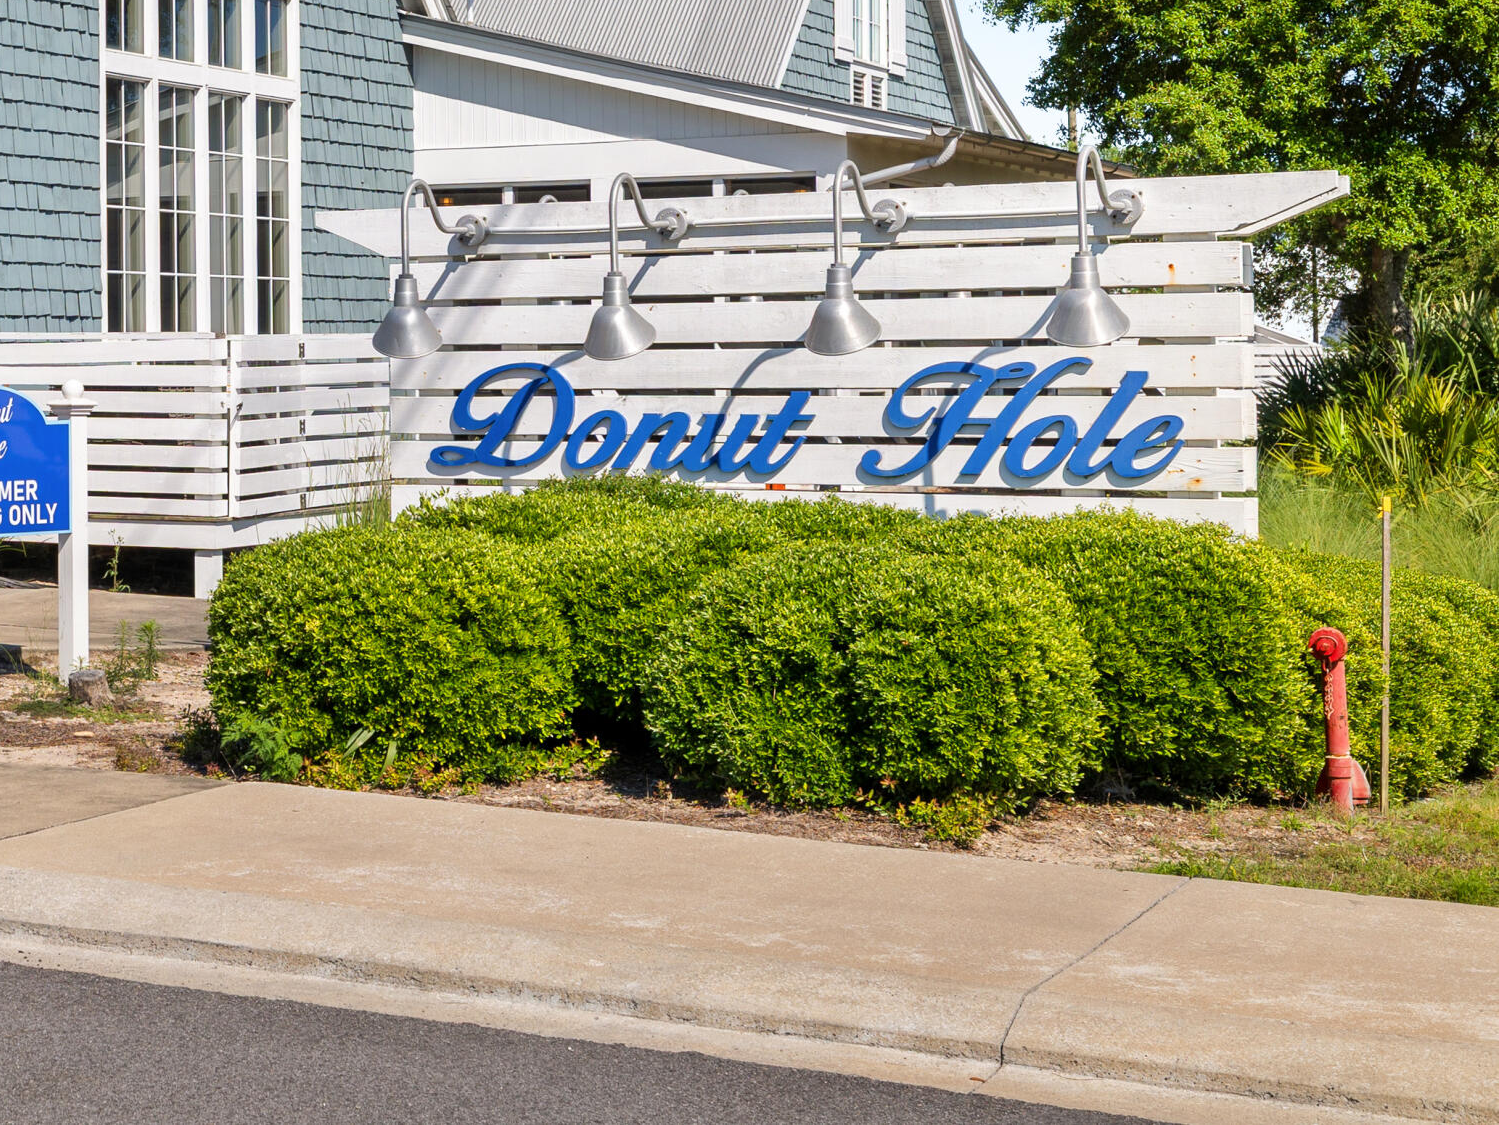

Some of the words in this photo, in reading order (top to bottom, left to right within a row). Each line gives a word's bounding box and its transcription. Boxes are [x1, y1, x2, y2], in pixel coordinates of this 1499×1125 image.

[429, 362, 814, 475] Donut
[861, 356, 1185, 479] Hole
[8, 502, 58, 526] ONLY
